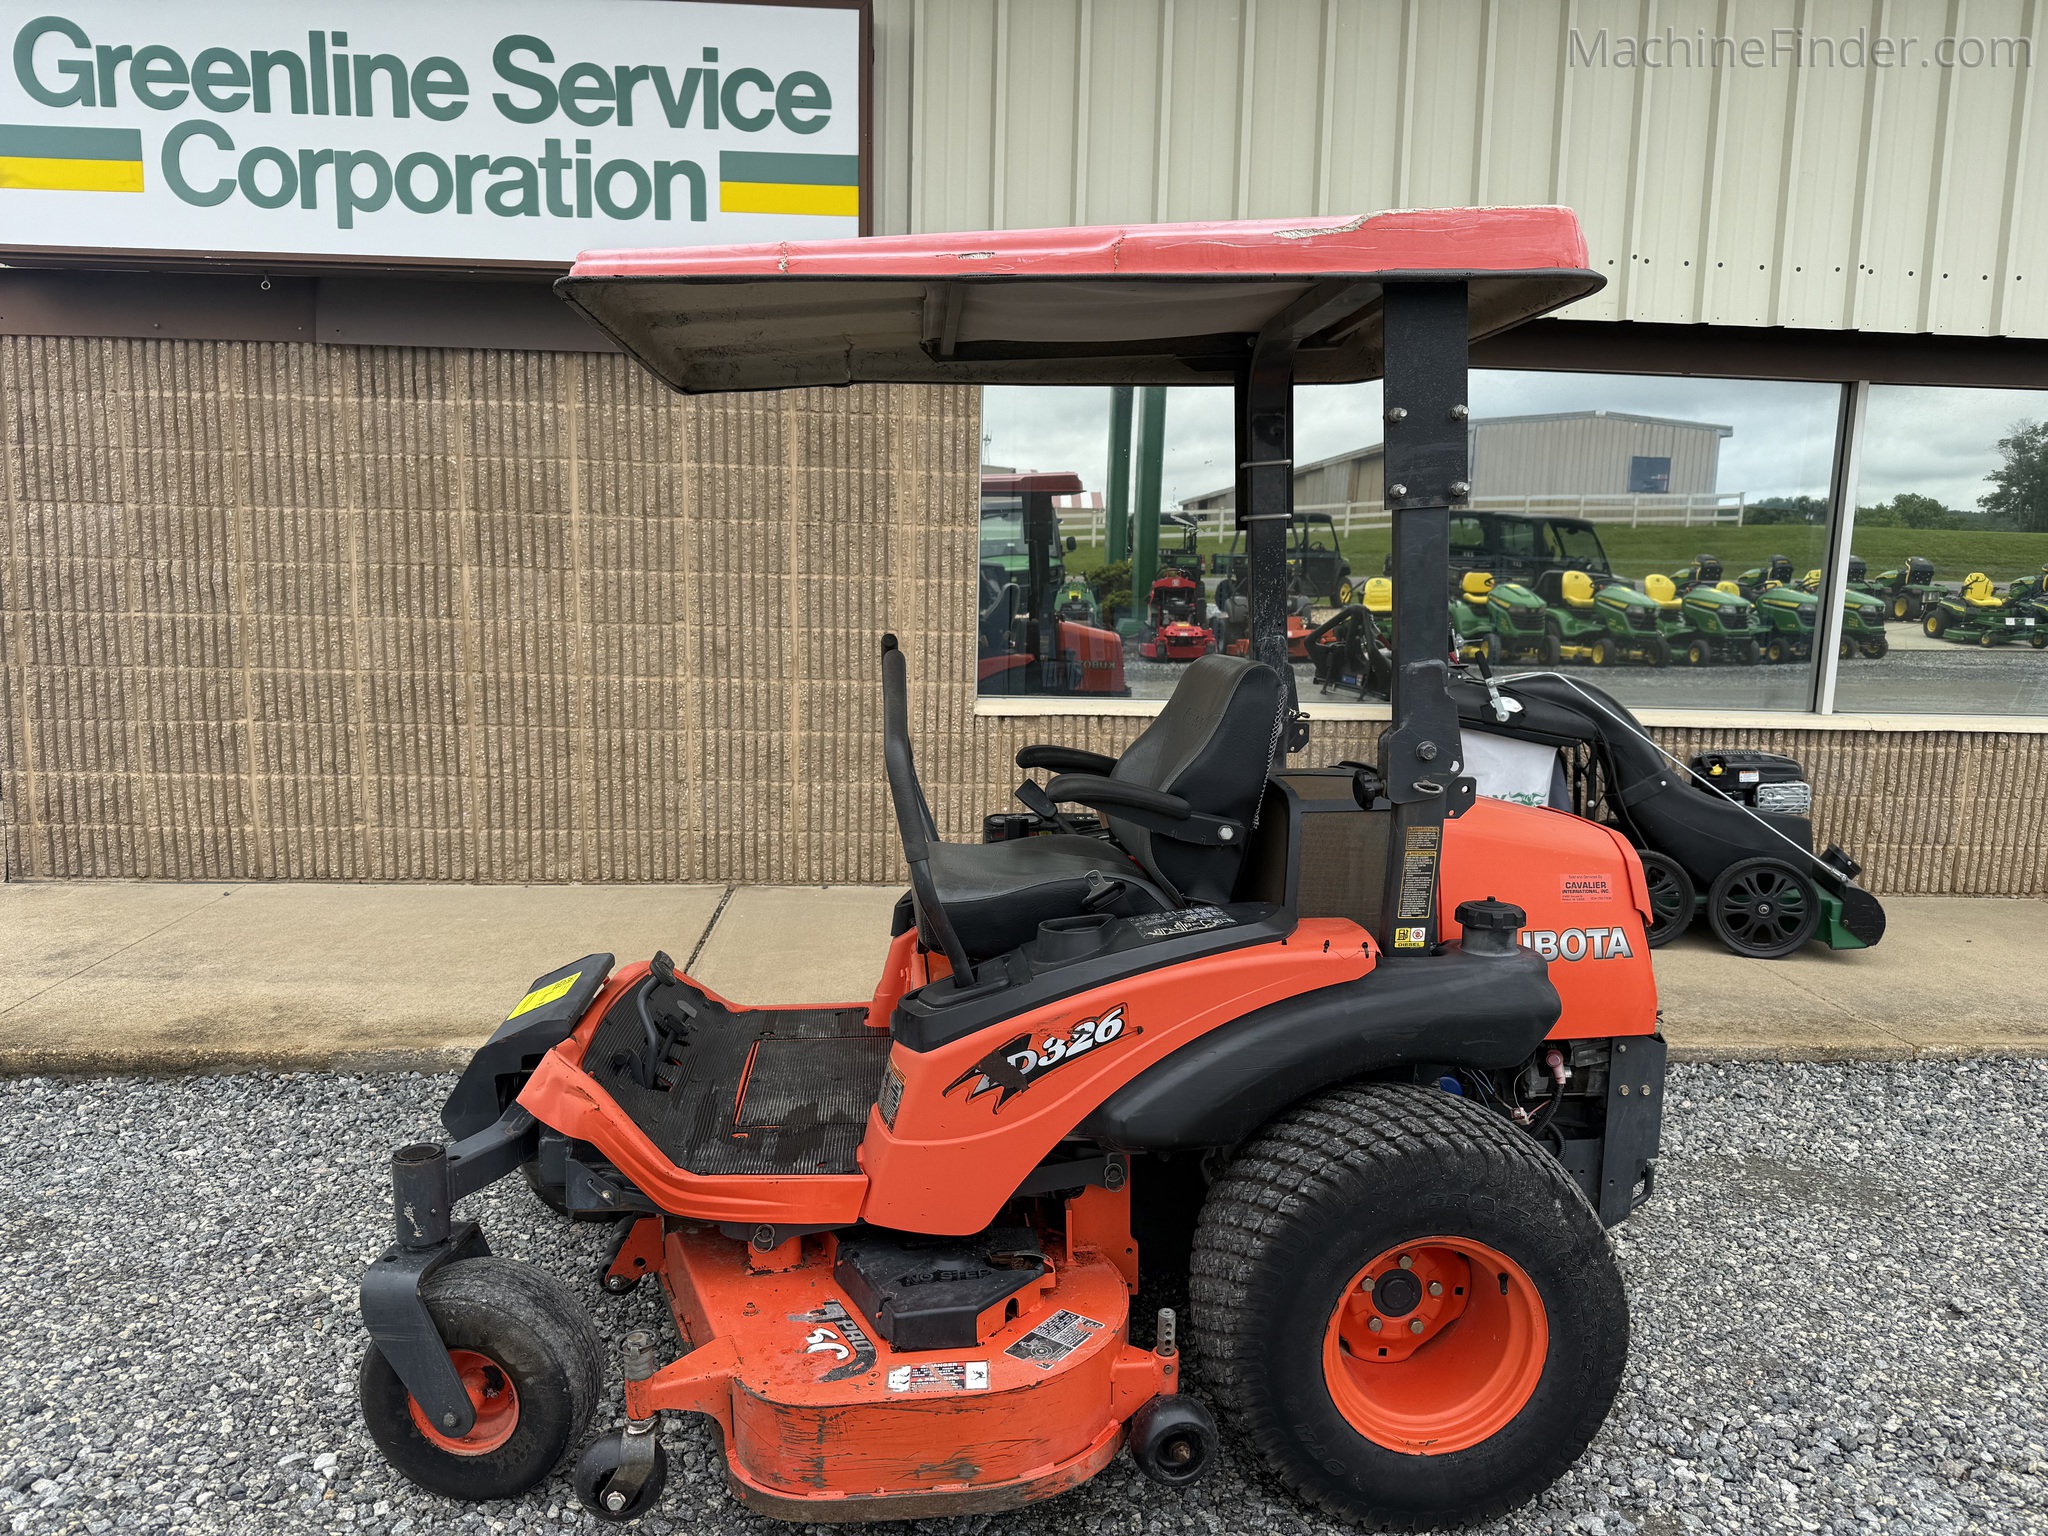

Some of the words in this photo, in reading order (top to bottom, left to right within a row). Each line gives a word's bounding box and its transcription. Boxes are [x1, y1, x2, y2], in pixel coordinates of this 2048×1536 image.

[13, 15, 470, 123] Greenline
[491, 34, 833, 135] Service
[161, 119, 708, 230] Corporation
[1565, 881, 1607, 889] CAVALIER
[1003, 1007, 1126, 1077] D326
[904, 1273, 934, 1286] NO
[939, 1269, 991, 1281] STEP
[835, 1320, 875, 1351] PRO
